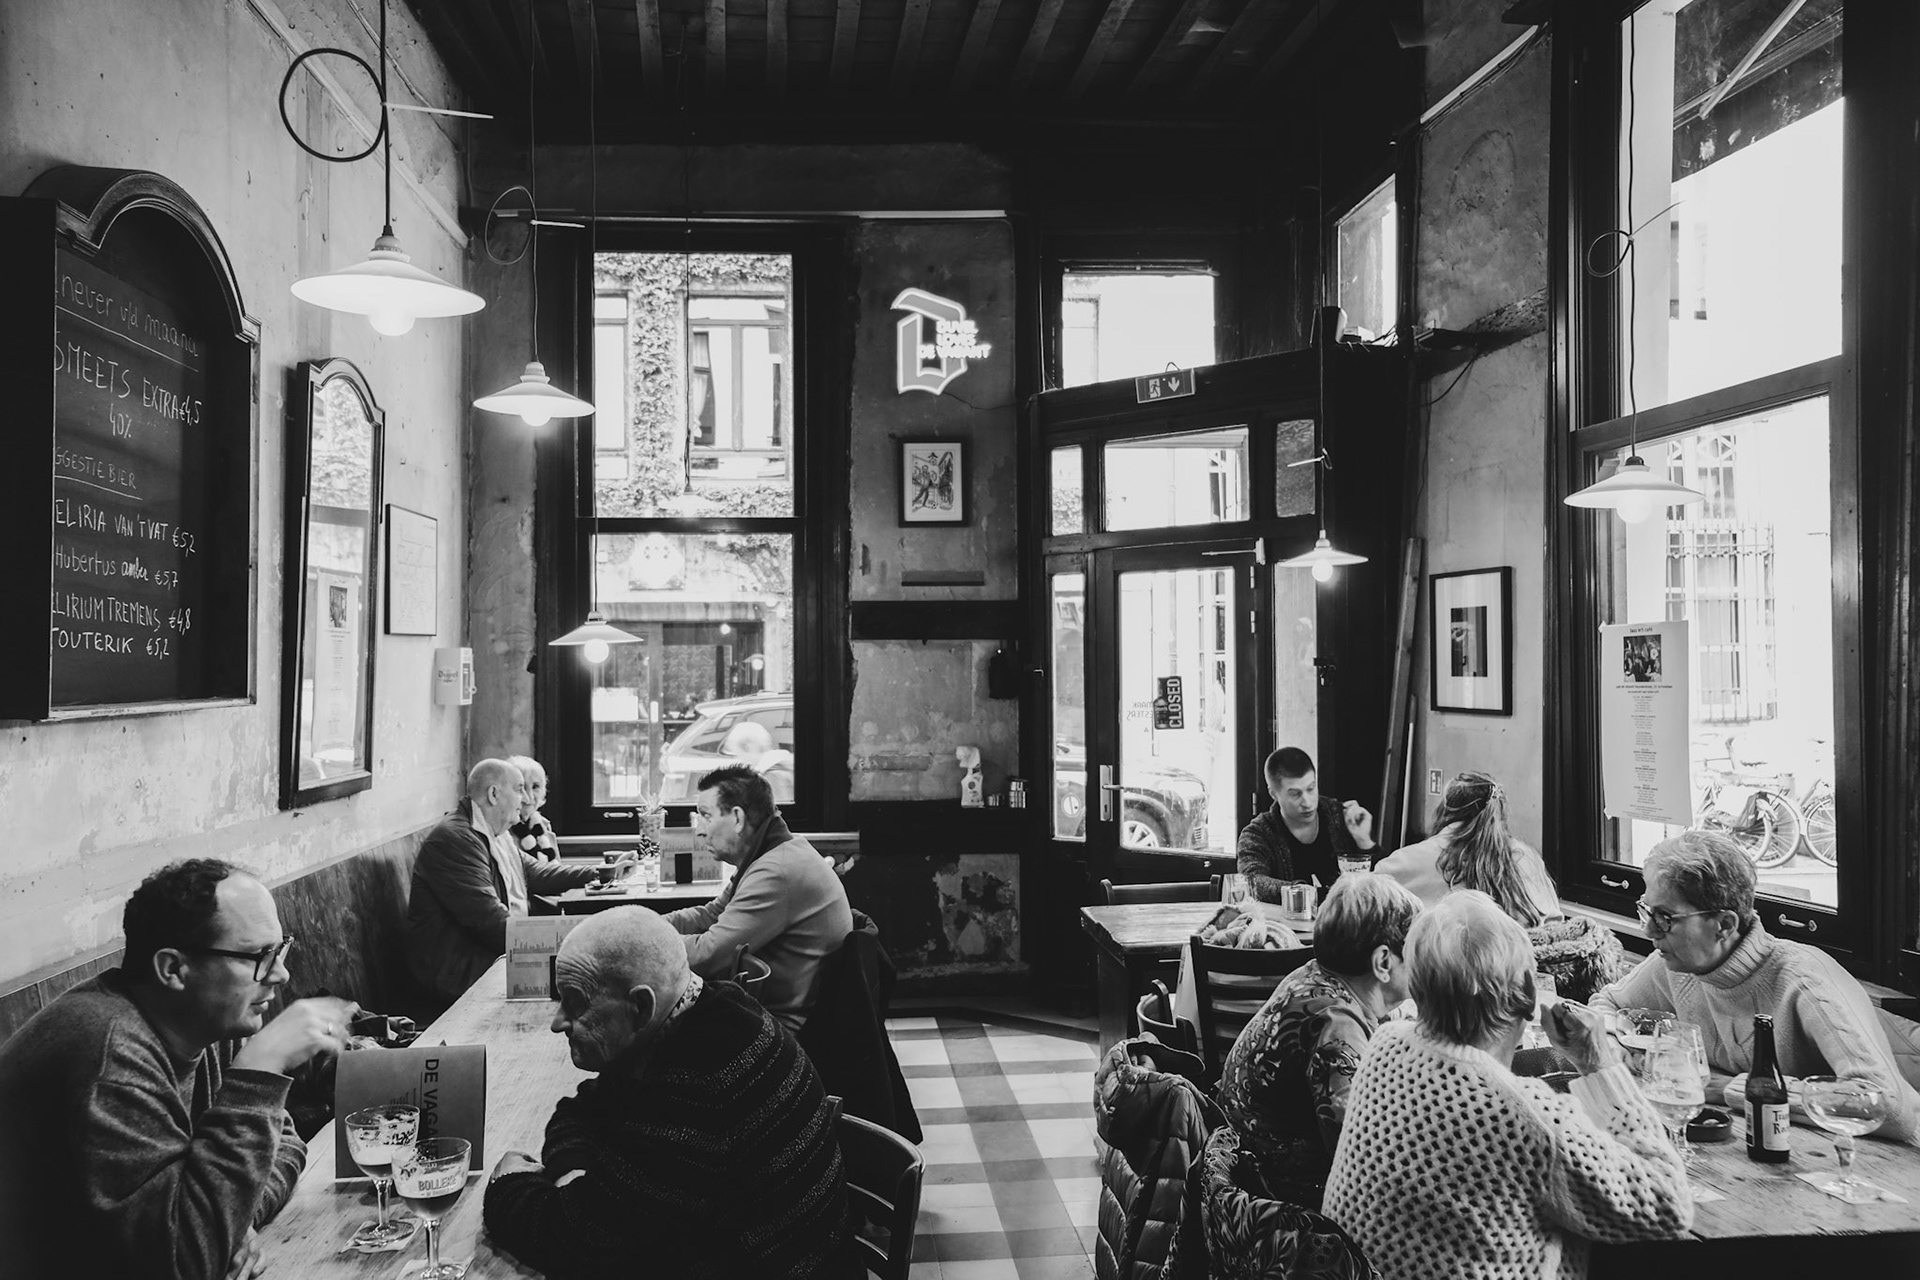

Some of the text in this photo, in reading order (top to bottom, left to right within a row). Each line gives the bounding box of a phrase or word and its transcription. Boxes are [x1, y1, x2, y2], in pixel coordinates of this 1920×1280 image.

[61, 273, 113, 315] never
[142, 377, 179, 419] EXTRA
[109, 403, 132, 439] 40%
[55, 449, 137, 490] GGESTIE BIER
[56, 499, 106, 533] ELIRIA
[115, 514, 133, 537] VAN
[147, 518, 168, 541] VAT
[56, 545, 116, 576] Hubertus
[52, 592, 104, 623] LIRIUM
[107, 597, 161, 632] TREMENS
[52, 628, 133, 653] OUTERIK
[1166, 678, 1182, 728] CLOSED
[425, 1059, 439, 1083] DE
